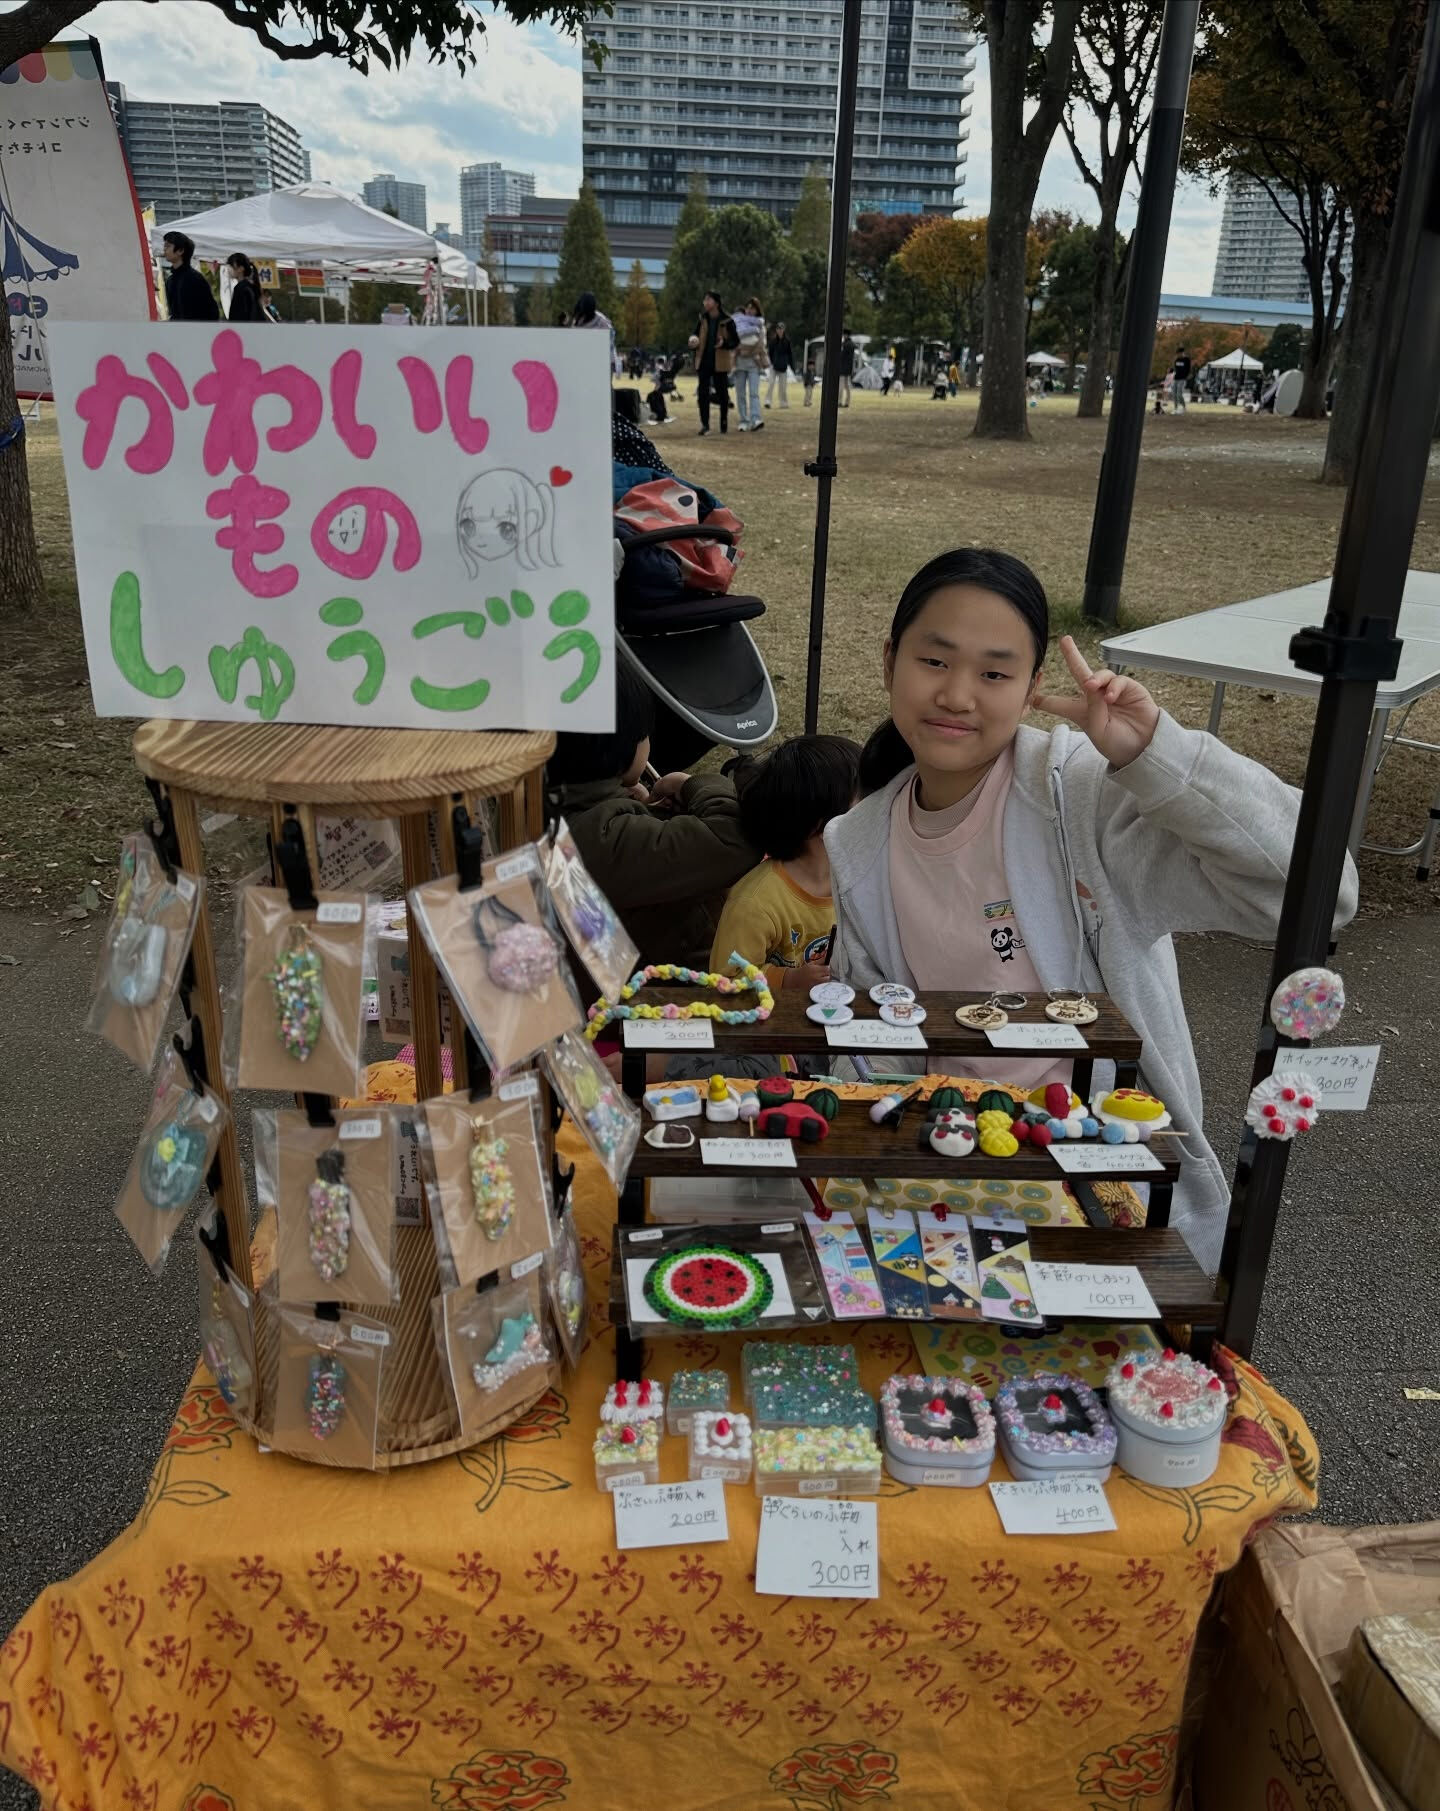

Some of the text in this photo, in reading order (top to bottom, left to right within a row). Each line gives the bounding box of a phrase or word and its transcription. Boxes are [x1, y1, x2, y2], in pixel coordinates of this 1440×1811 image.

[76, 329, 558, 475] かわいい
[206, 474, 421, 597] もの
[109, 571, 600, 720] しゅうごう
[664, 1031, 708, 1039] 300円
[1316, 1076, 1358, 1090] 300円
[1039, 1269, 1131, 1284] 季節のしおり
[1089, 1293, 1135, 1305] 100円
[671, 1509, 716, 1526] 200円
[1055, 1504, 1099, 1521] 400円
[811, 1560, 870, 1585] 300円
